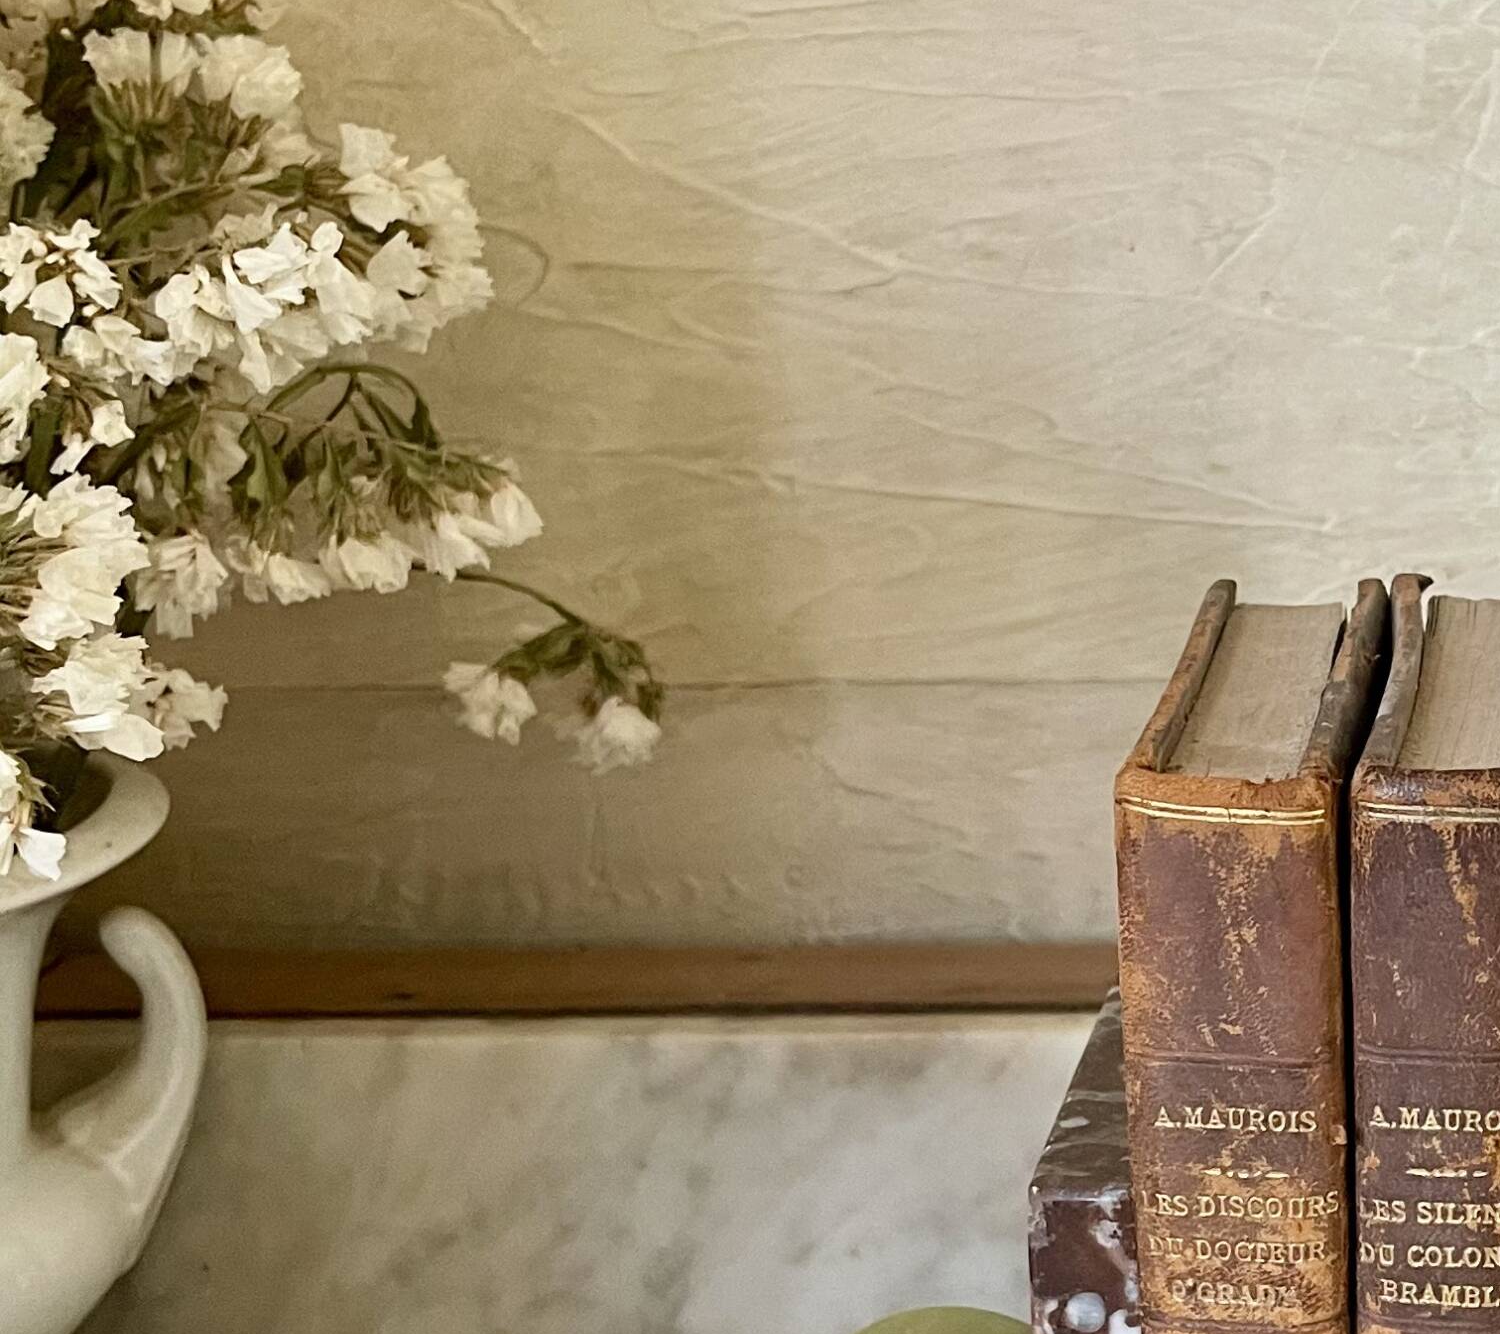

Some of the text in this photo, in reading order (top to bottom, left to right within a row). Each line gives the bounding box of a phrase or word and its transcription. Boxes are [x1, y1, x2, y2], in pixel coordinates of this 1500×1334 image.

[1141, 1190, 1340, 1219] LES DISCOURS
[1359, 1197, 1406, 1223] LES
[1148, 1234, 1327, 1264] DU DOCTEUR
[1360, 1241, 1395, 1267] DU
